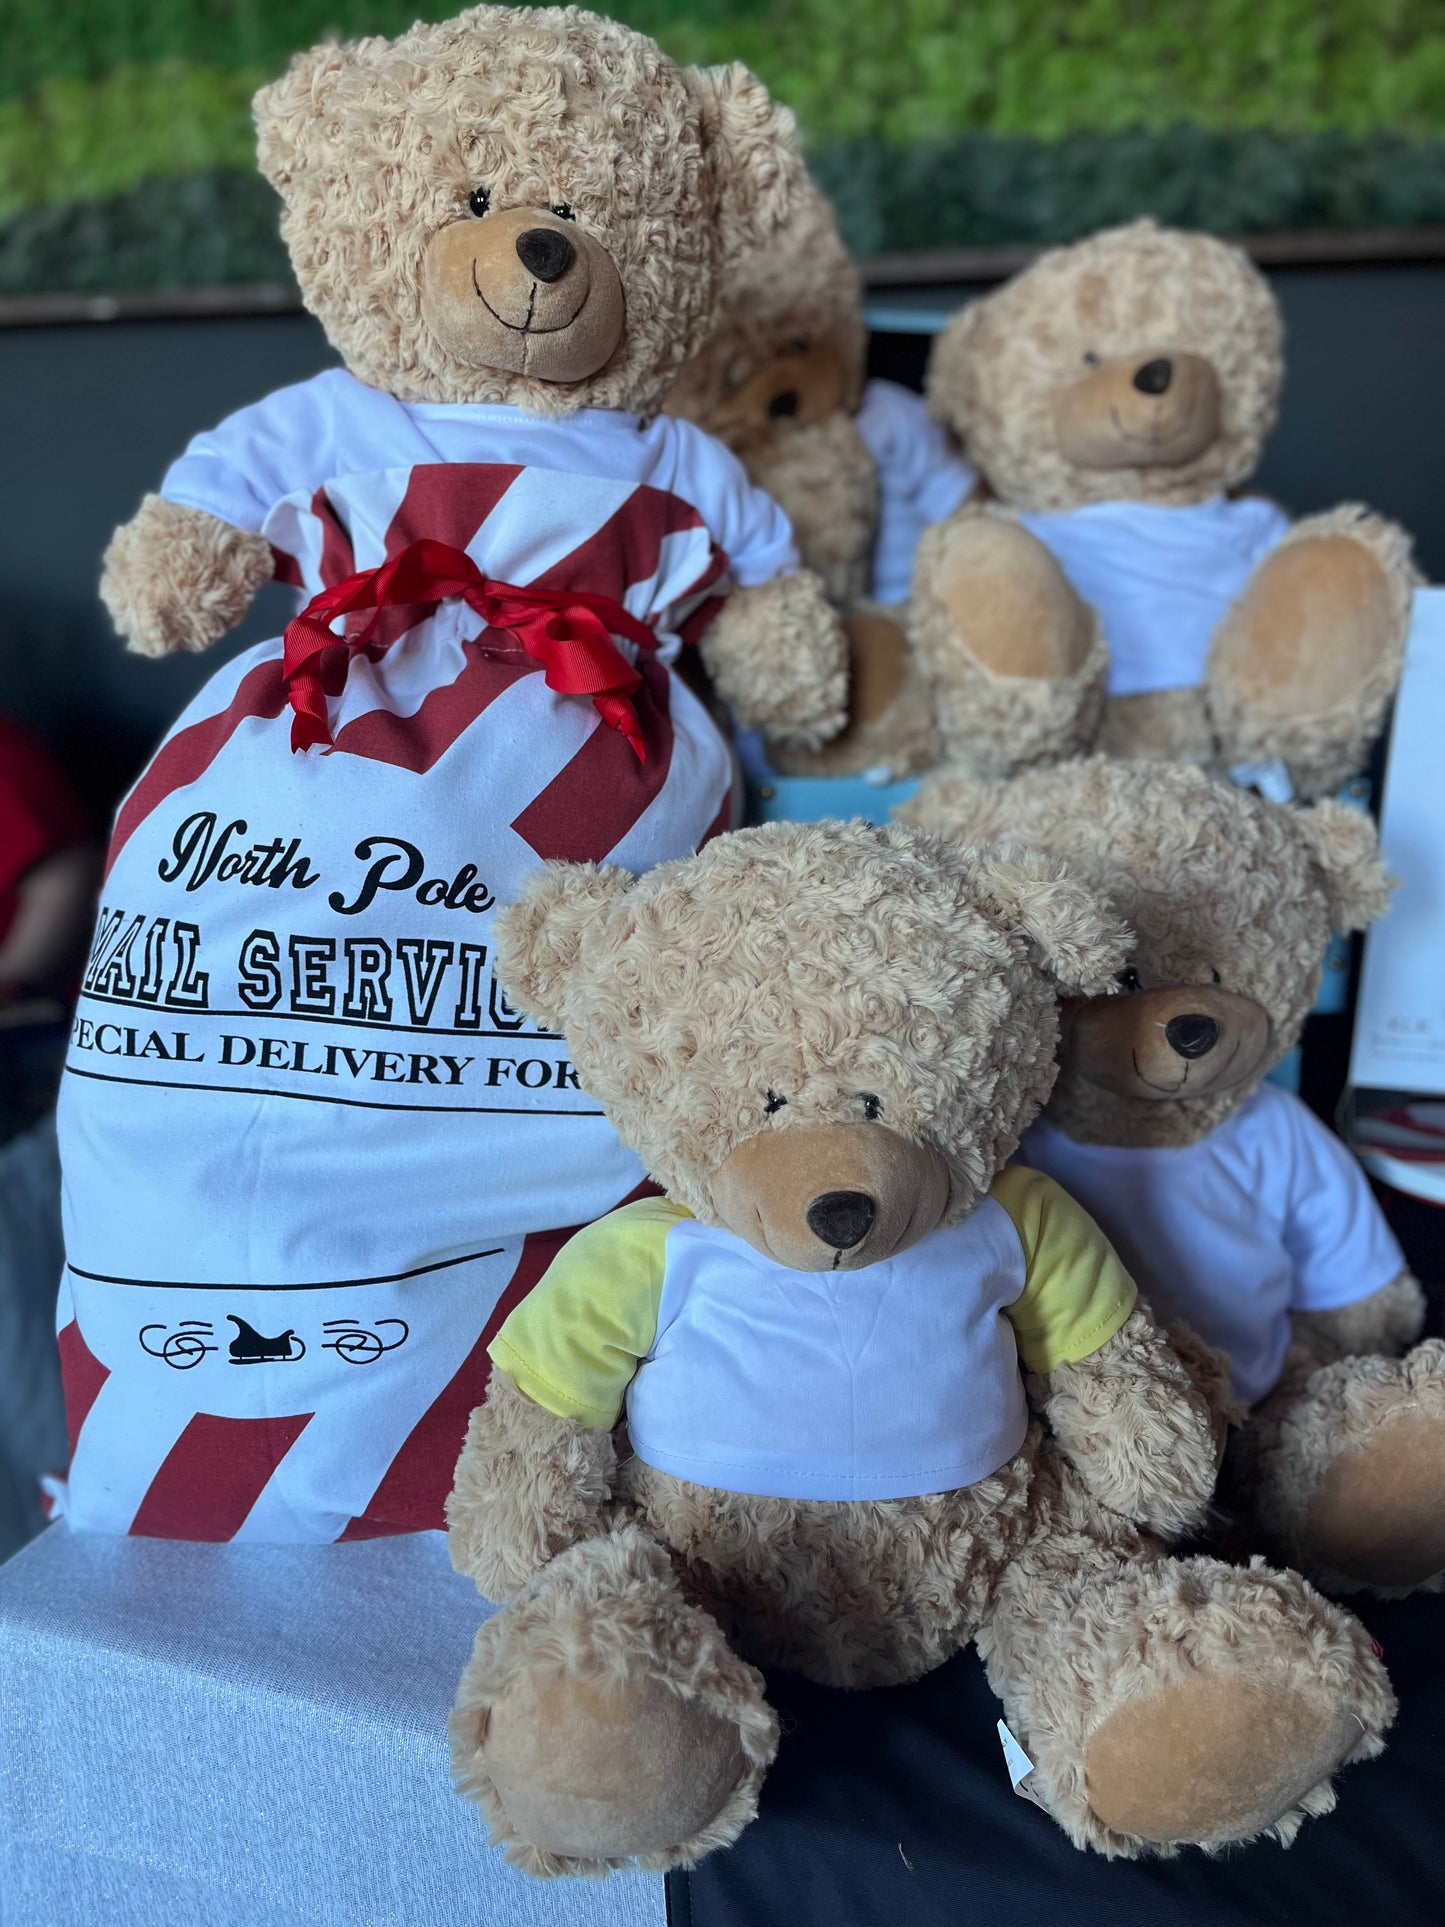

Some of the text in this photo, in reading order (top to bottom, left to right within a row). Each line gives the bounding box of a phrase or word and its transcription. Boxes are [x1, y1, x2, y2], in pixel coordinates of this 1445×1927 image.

[158, 811, 496, 915] North Pole
[82, 906, 210, 1009] MAIL
[70, 1016, 582, 1090] PECIAL DELIVERY FOR
